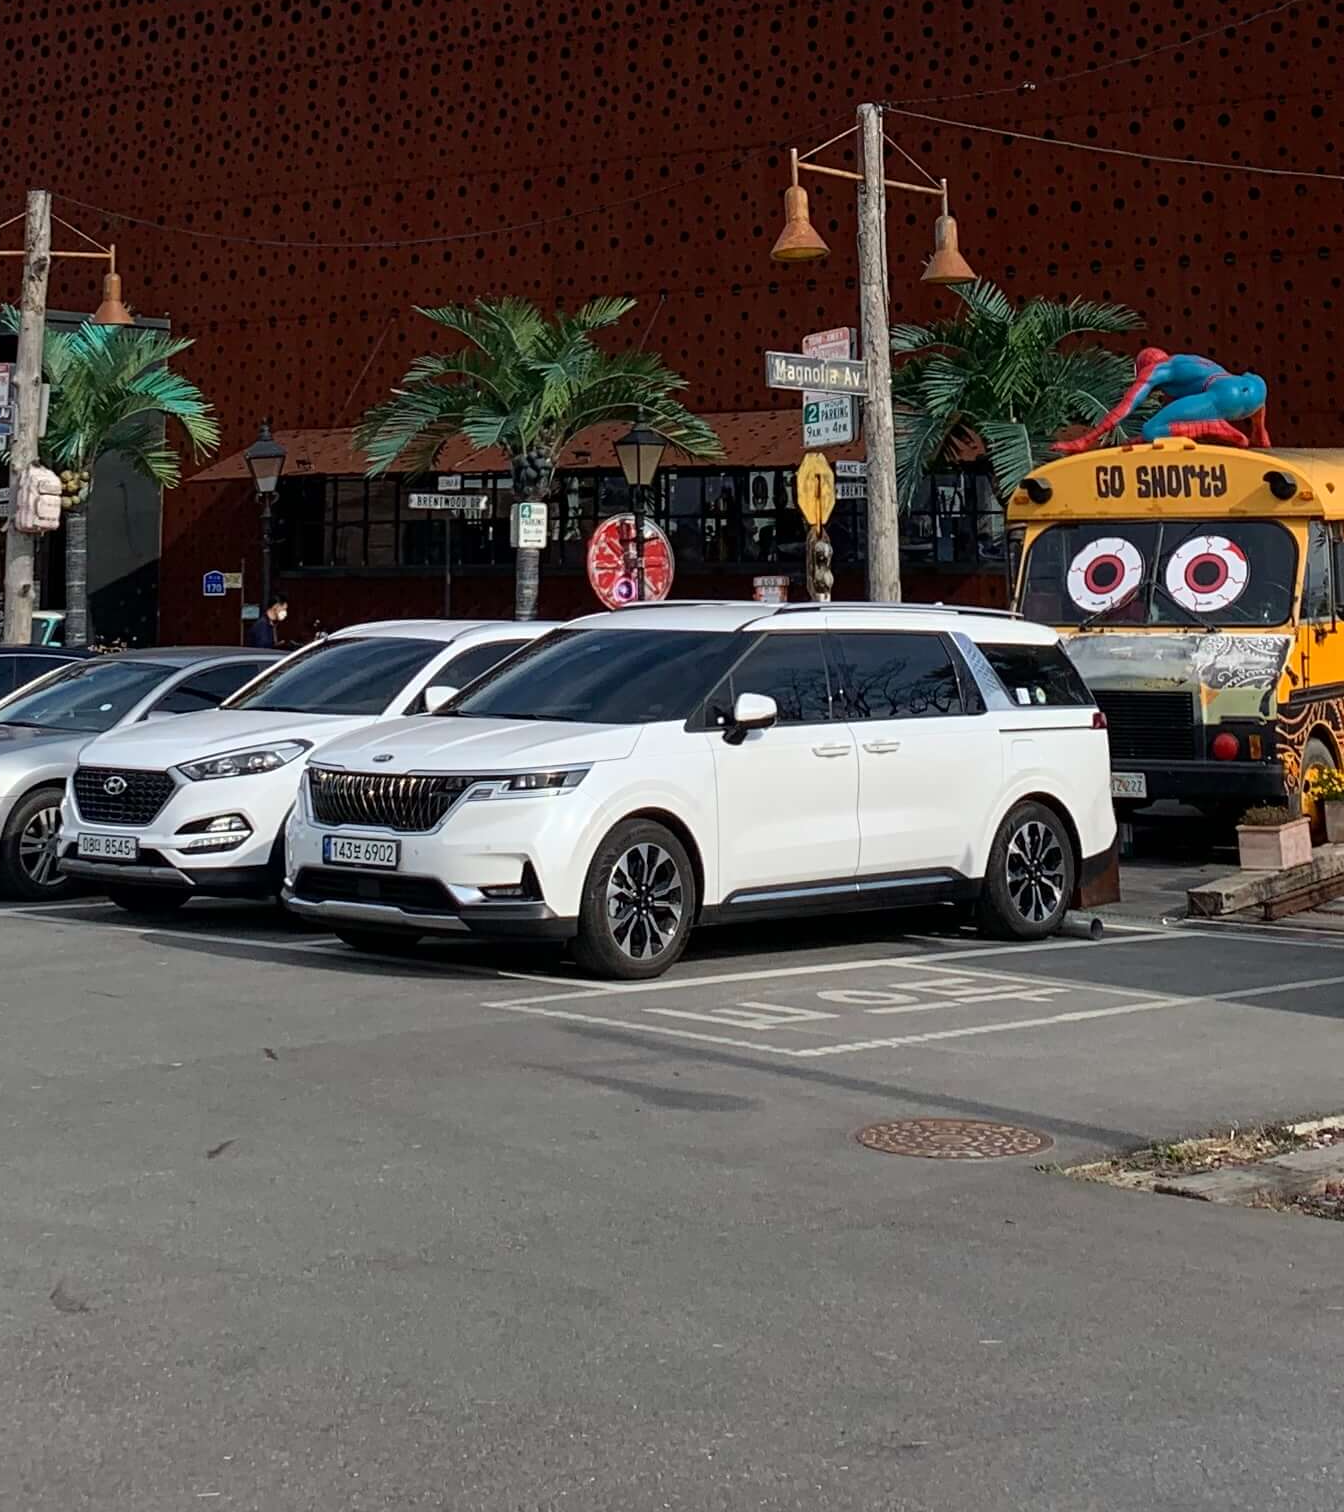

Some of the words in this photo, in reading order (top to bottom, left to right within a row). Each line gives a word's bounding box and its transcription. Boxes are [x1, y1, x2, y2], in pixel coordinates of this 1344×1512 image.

[775, 359, 839, 385] Magnolia
[845, 368, 860, 386] Av
[808, 406, 817, 422] 2
[821, 406, 848, 421] PARKING
[1096, 465, 1125, 498] GO
[417, 496, 467, 508] BRENTWOOD
[522, 505, 530, 517] 4
[207, 584, 222, 592] 170
[105, 839, 130, 855] 8545
[364, 843, 393, 862] 6902
